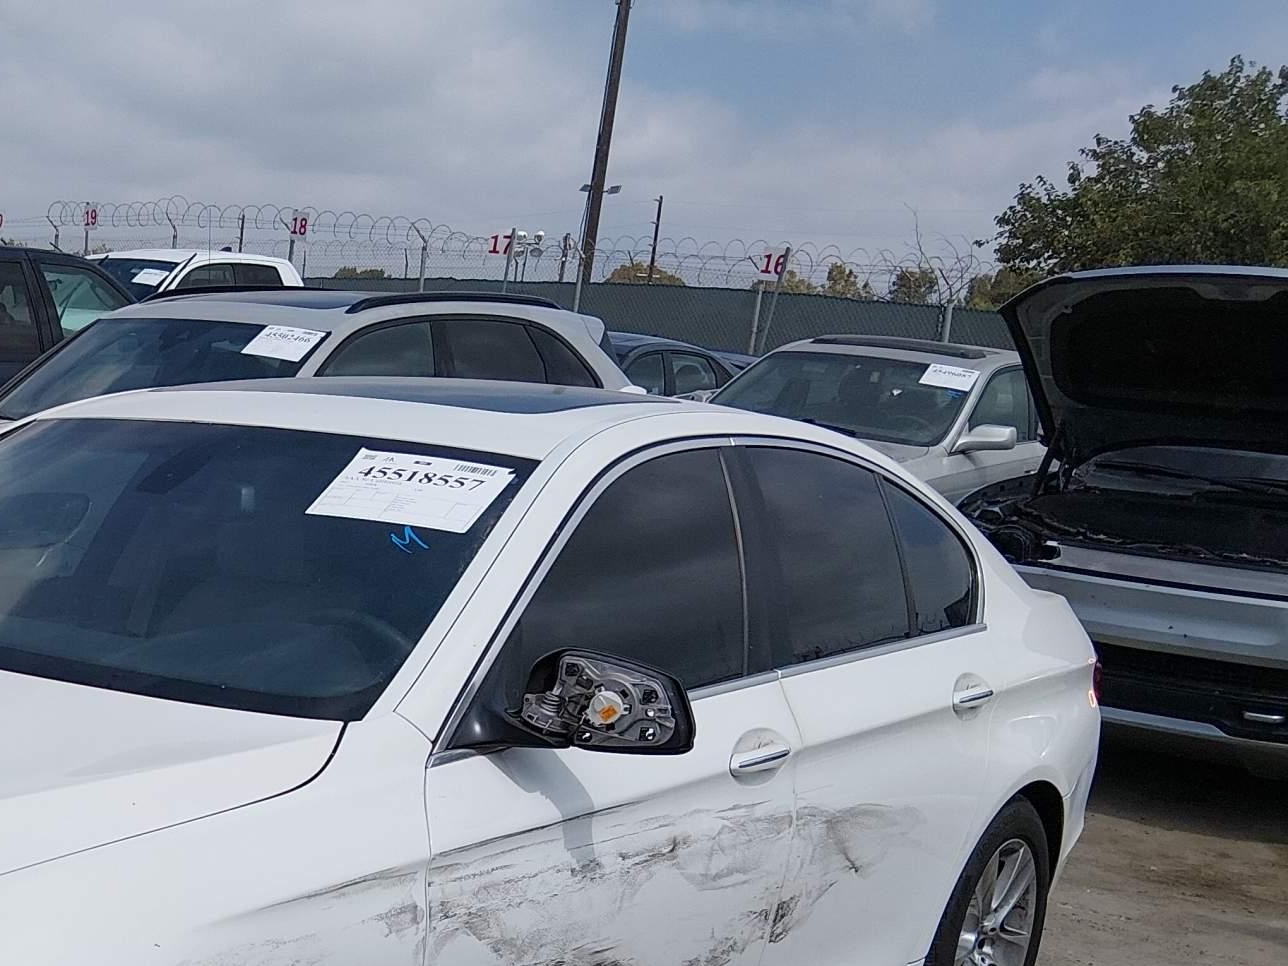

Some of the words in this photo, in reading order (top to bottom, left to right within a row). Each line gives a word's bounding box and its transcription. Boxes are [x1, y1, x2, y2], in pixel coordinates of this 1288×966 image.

[84, 208, 97, 227] 19
[290, 216, 308, 236] 18
[488, 234, 513, 255] 17
[760, 252, 785, 276] 16
[358, 465, 487, 491] 45518557
